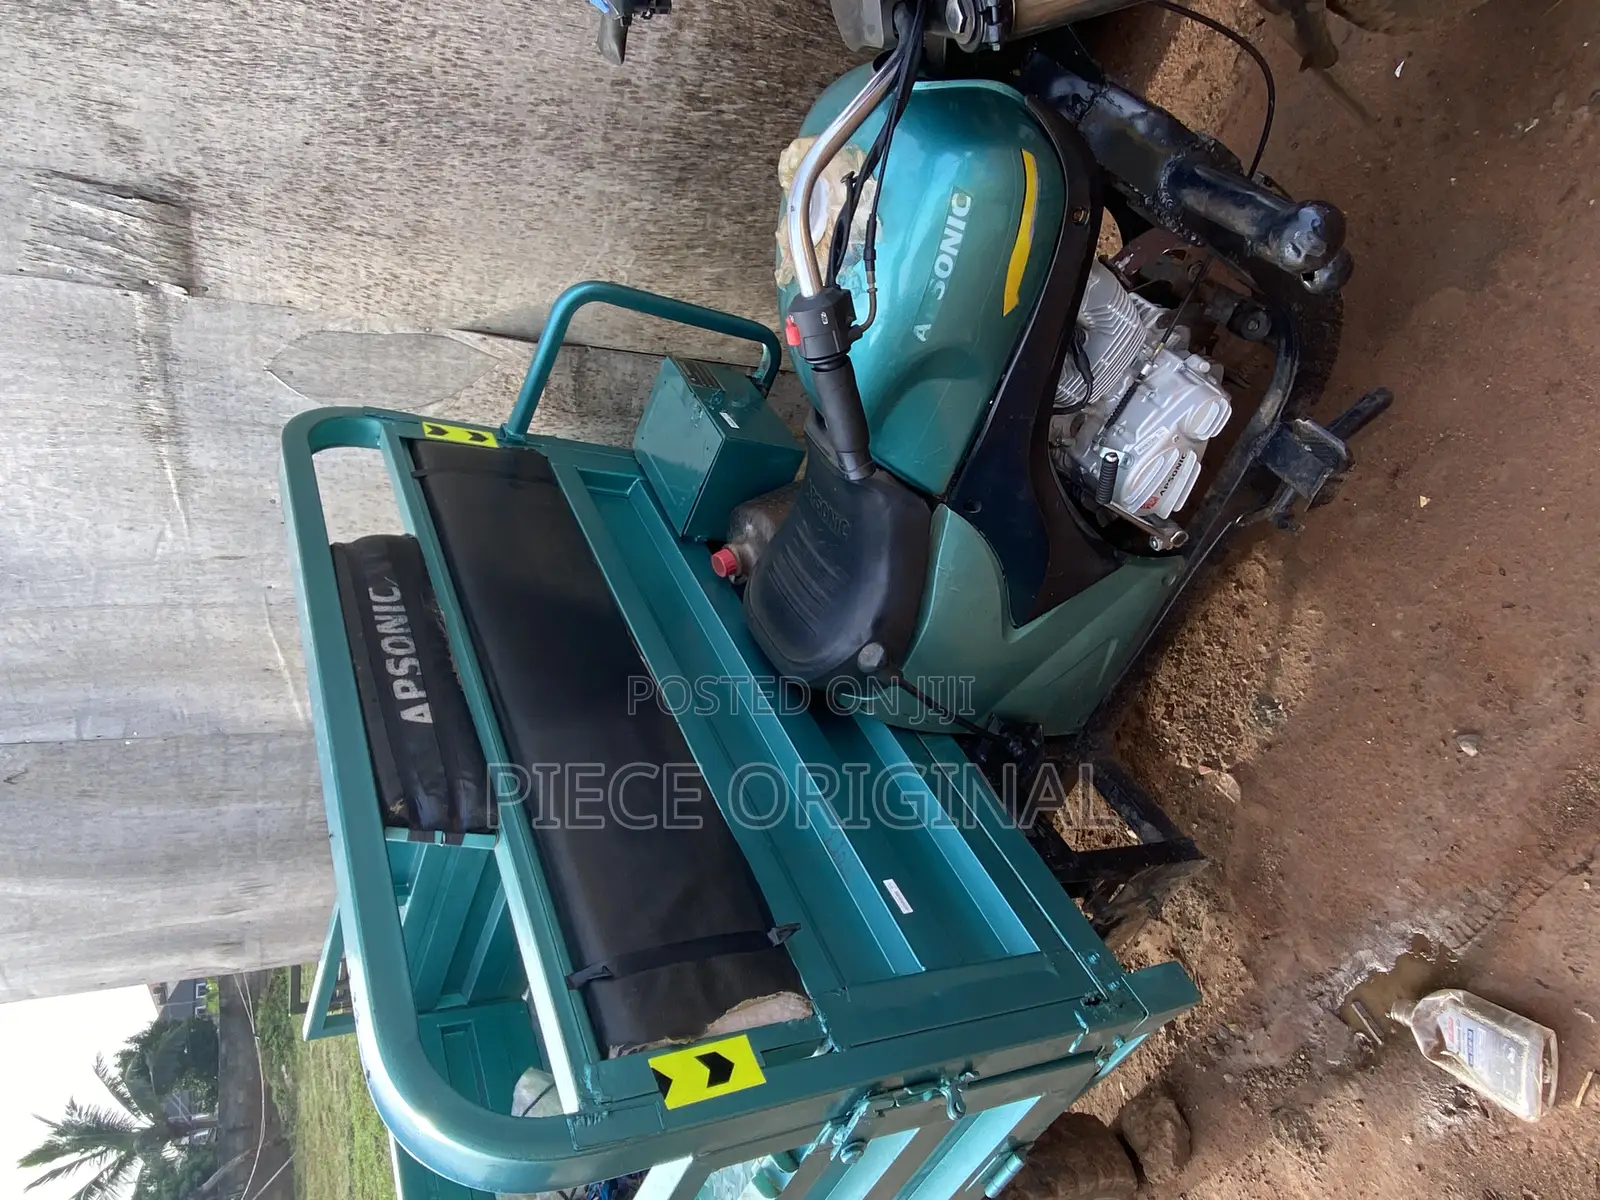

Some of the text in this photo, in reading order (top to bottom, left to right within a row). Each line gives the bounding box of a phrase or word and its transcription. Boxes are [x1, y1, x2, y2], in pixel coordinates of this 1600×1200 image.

[913, 193, 972, 342] ASONIC
[1160, 453, 1187, 496] APSONIC
[368, 586, 433, 724] APSONIC
